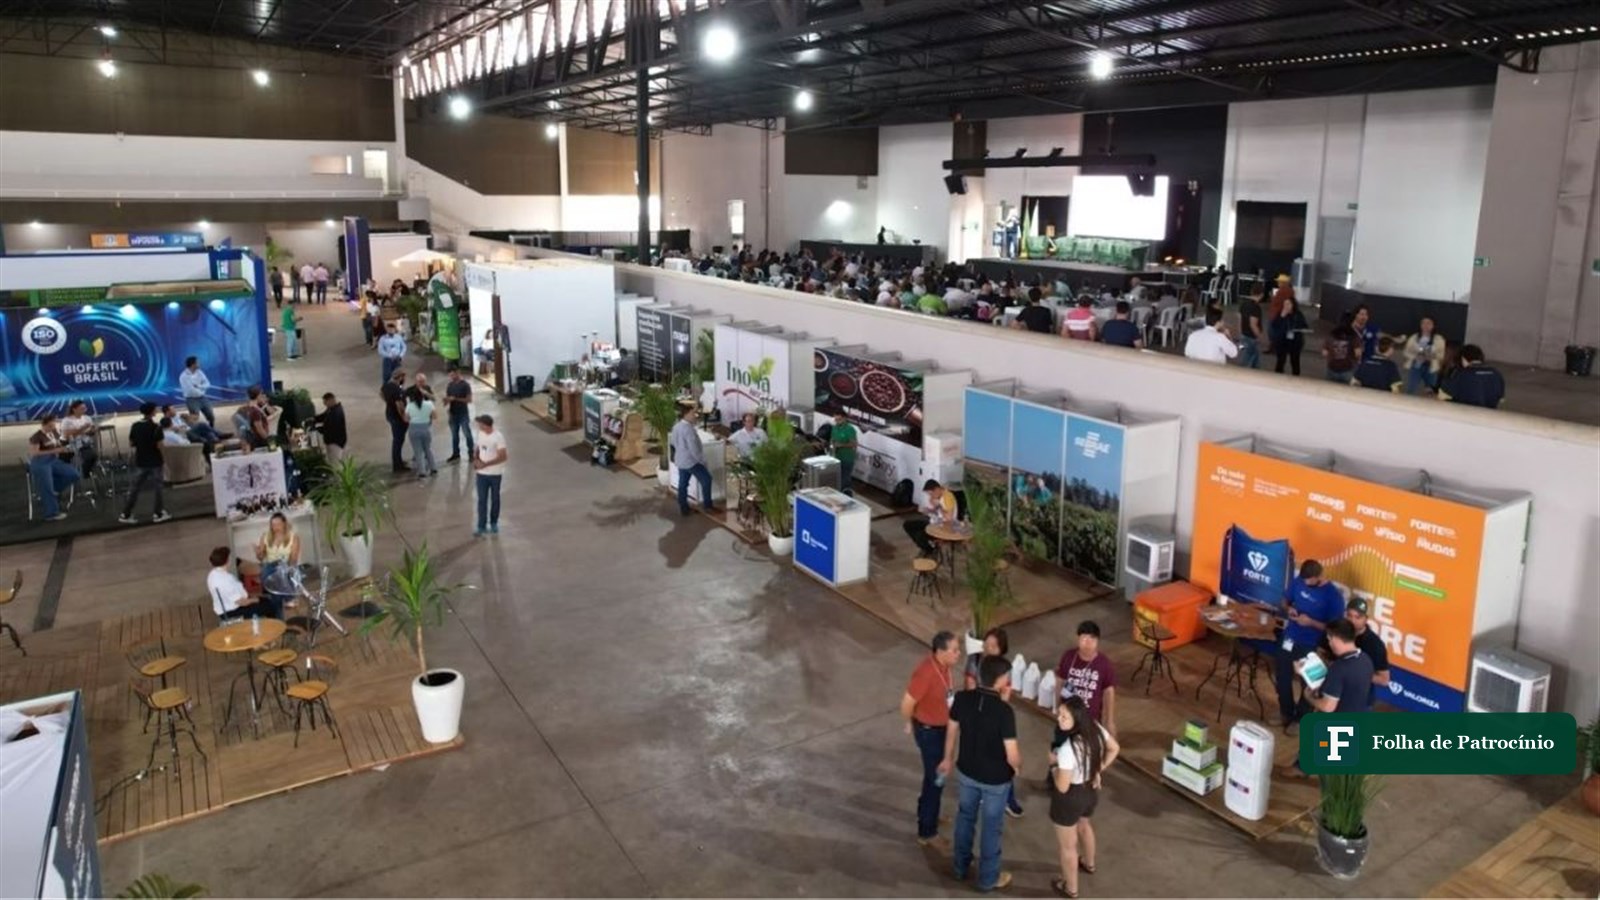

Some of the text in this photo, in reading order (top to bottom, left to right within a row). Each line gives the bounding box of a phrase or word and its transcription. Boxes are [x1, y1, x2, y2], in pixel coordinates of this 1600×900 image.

[63, 361, 128, 374] BIOFERTIL
[74, 371, 119, 384] BRASIL
[1243, 568, 1271, 584] FORTE
[1403, 689, 1440, 710] VALORIZA
